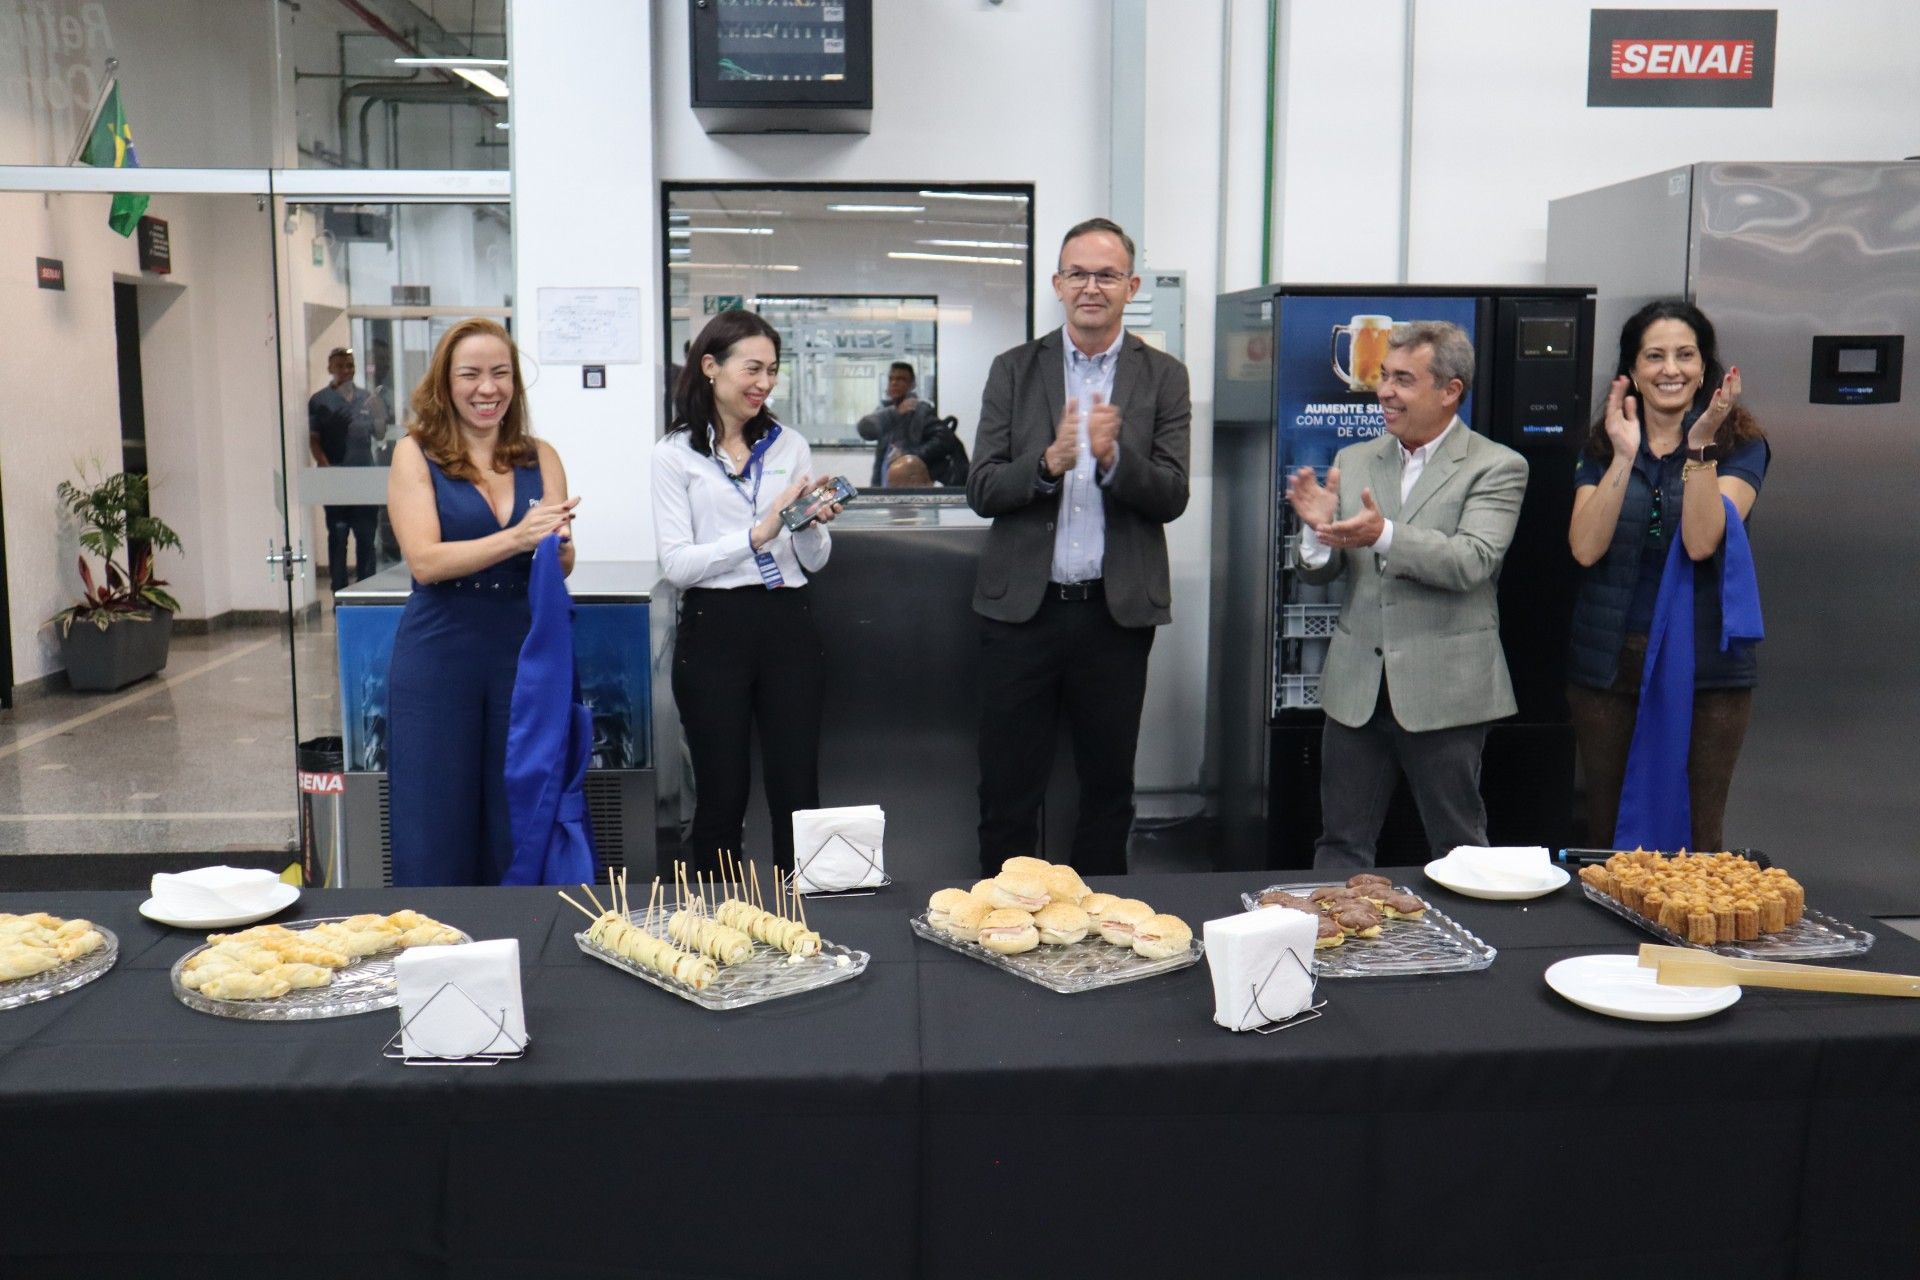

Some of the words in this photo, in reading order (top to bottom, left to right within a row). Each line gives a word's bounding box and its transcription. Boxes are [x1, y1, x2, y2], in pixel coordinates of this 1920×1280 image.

[1621, 44, 1744, 74] SENAI
[1305, 403, 1364, 414] AUMENTE
[1366, 403, 1384, 414] SU
[1296, 415, 1323, 426] COM
[1327, 415, 1336, 426] O
[1338, 427, 1353, 437] DE
